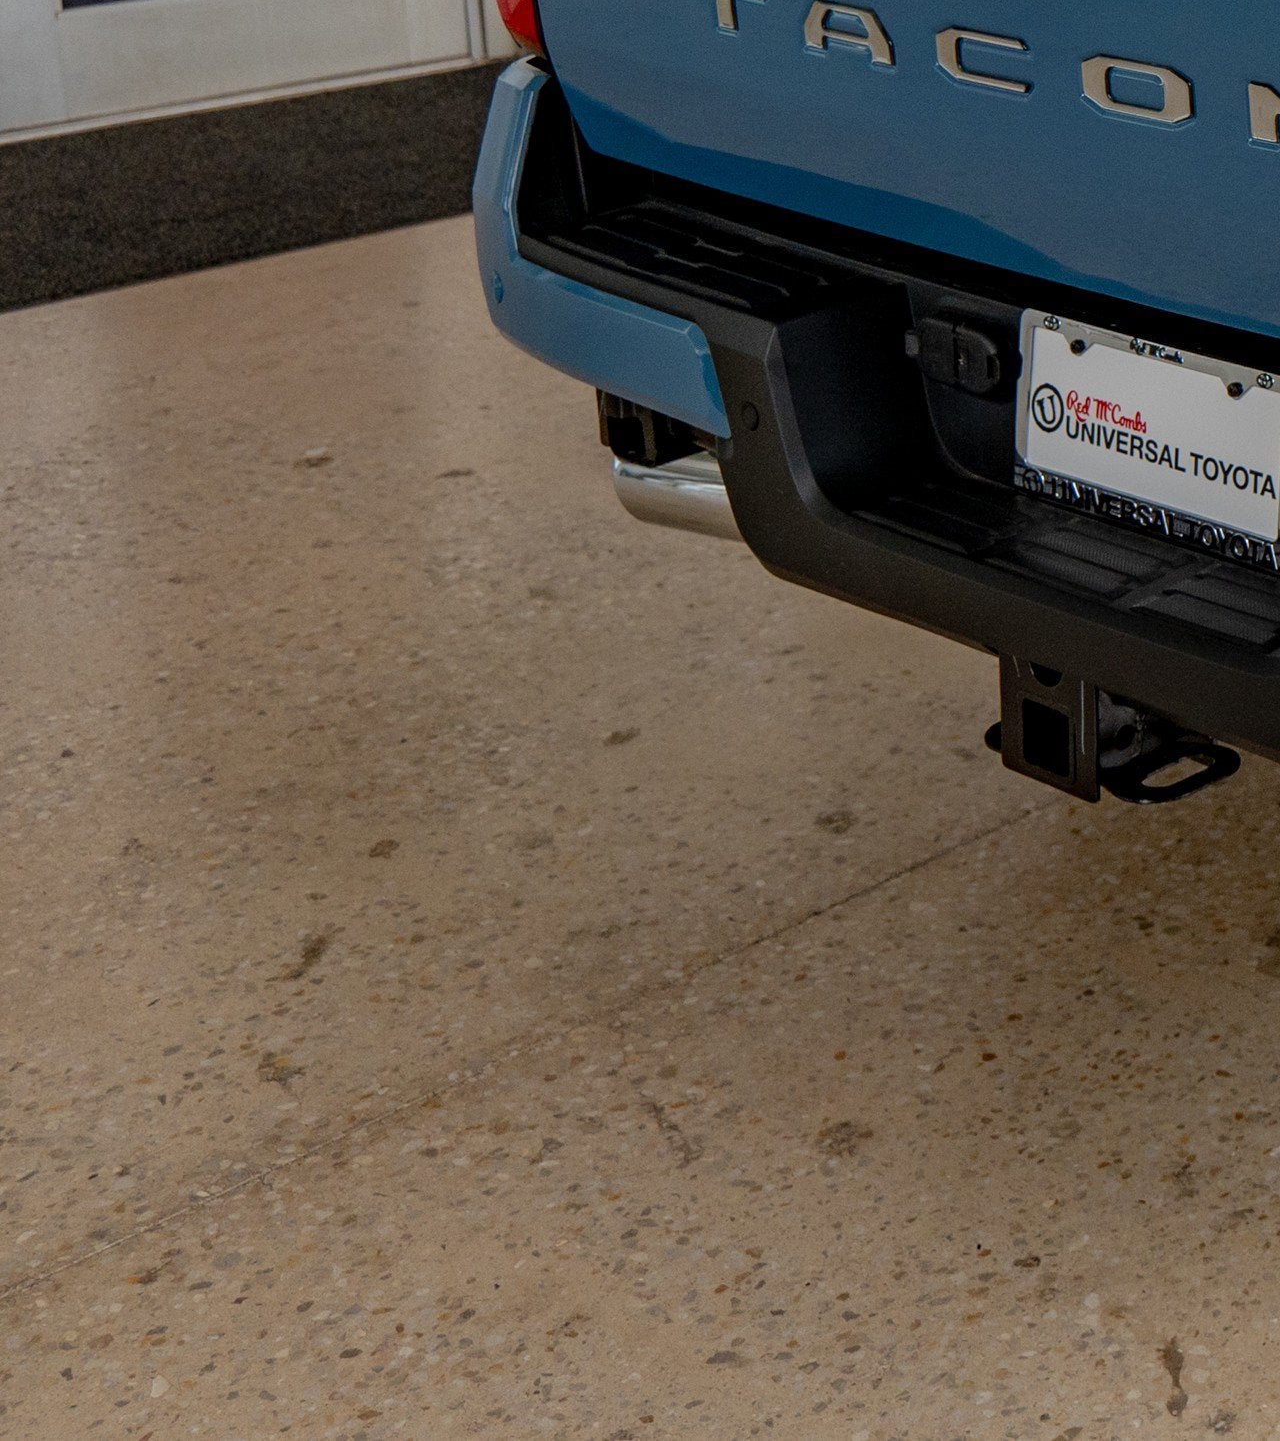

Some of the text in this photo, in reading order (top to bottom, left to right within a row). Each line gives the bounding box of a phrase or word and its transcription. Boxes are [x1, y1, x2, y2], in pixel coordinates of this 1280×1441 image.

[1066, 390, 1147, 434] Red McCombs
[1065, 415, 1277, 500] UNIVERSAL TOYOTA
